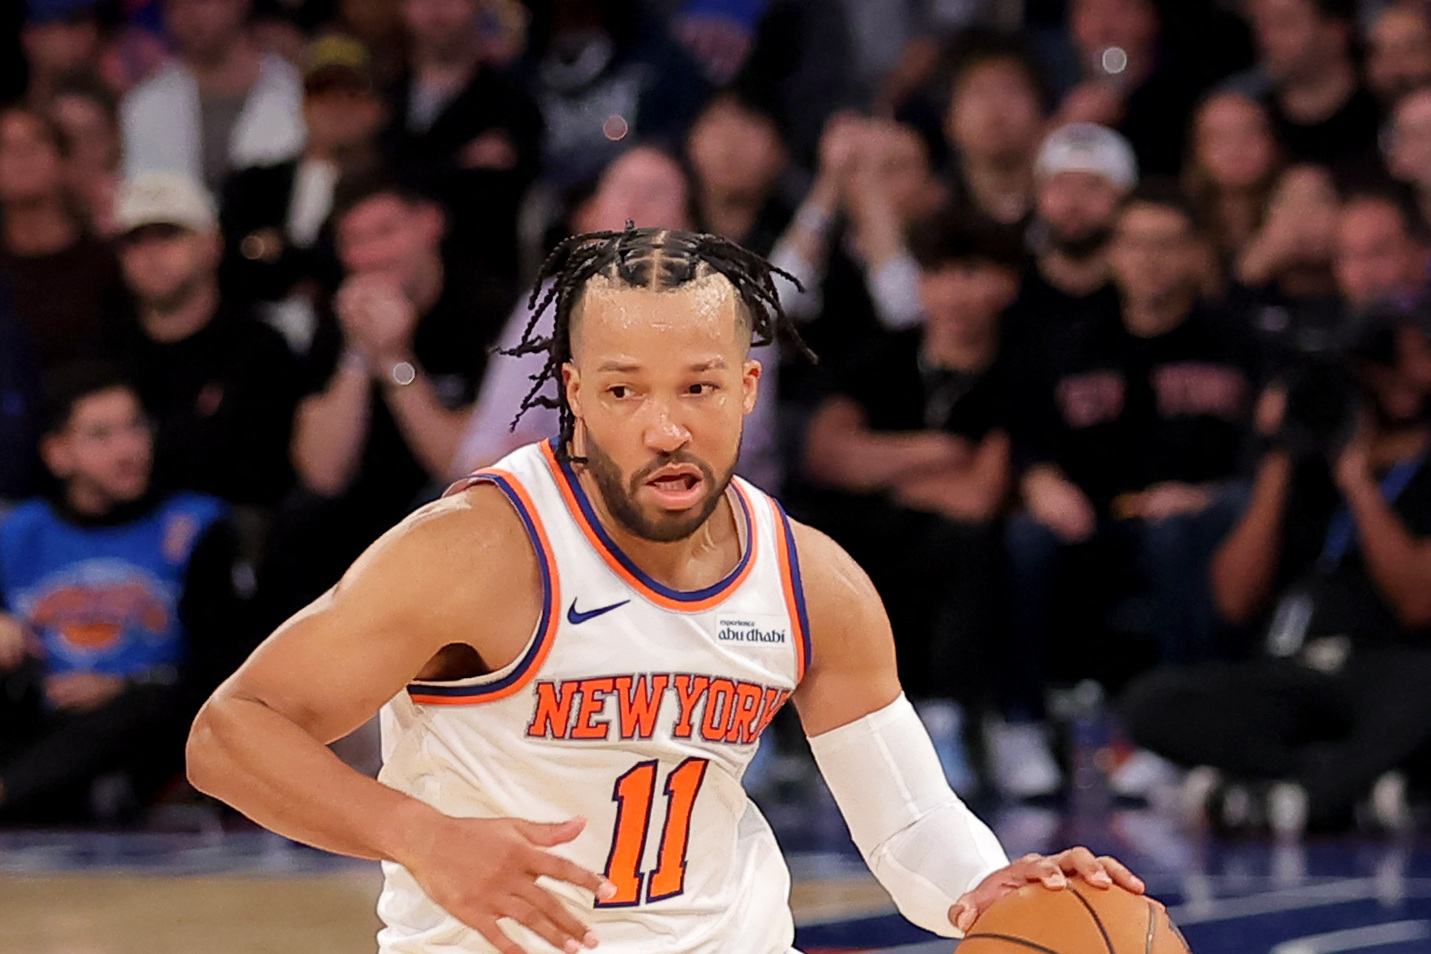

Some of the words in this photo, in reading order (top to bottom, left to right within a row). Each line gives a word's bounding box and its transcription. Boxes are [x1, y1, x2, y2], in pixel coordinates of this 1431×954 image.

[718, 628, 744, 641] abu
[746, 629, 785, 643] dhabi
[525, 673, 670, 741] NEW
[593, 756, 710, 909] 11
